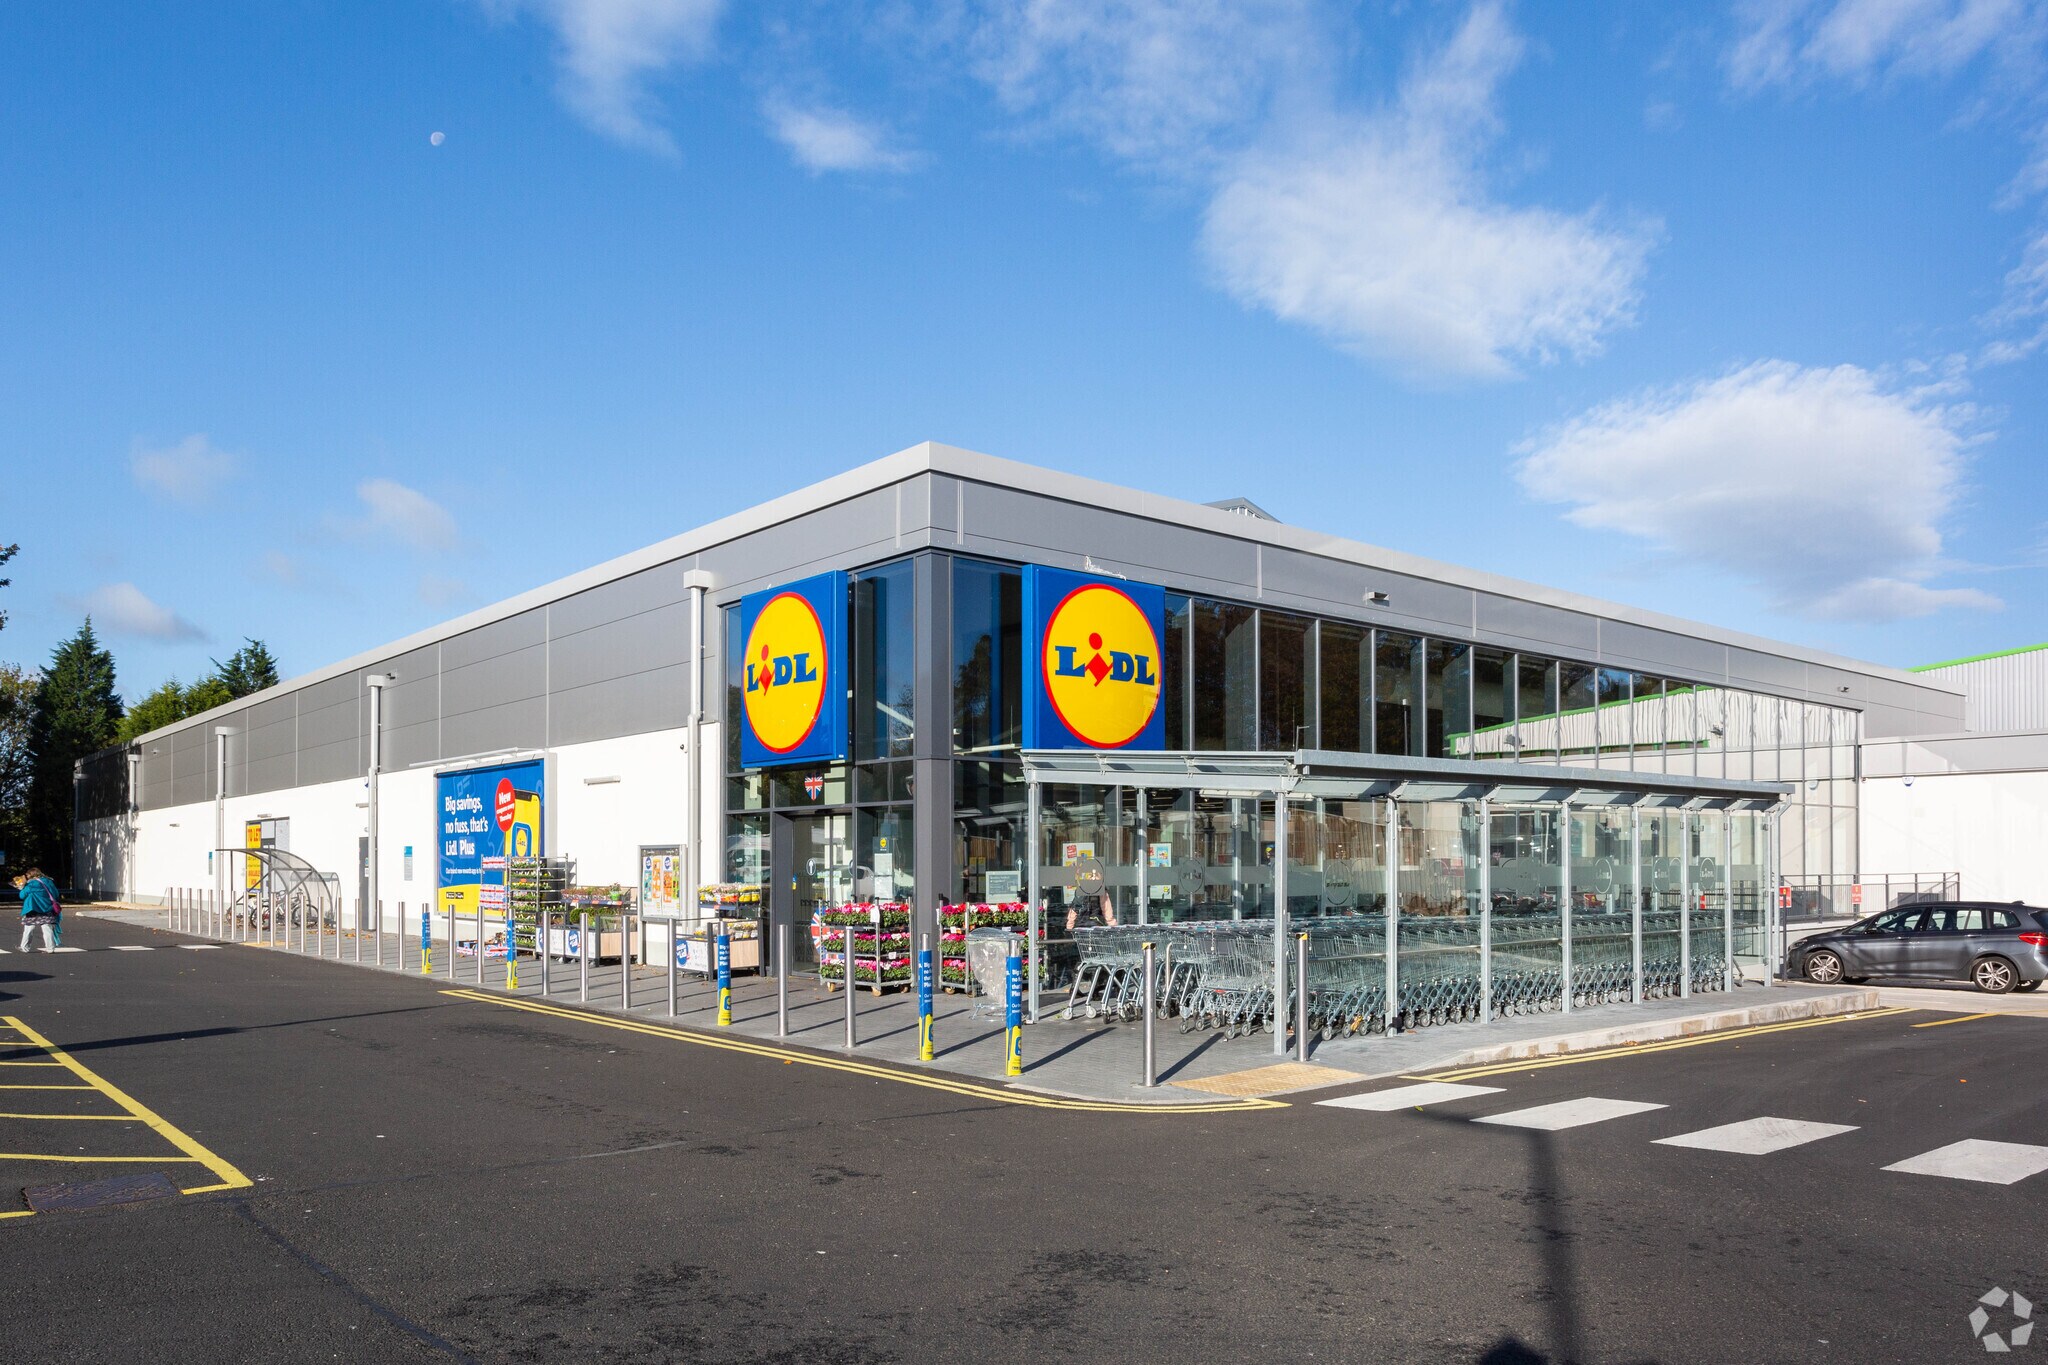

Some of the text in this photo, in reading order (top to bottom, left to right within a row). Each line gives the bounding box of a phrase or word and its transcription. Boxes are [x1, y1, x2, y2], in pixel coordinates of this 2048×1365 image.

[445, 794, 482, 815] Big savings,
[498, 792, 511, 805] New
[445, 816, 488, 835] no fuss, that's
[446, 839, 475, 856] Lidl Plus
